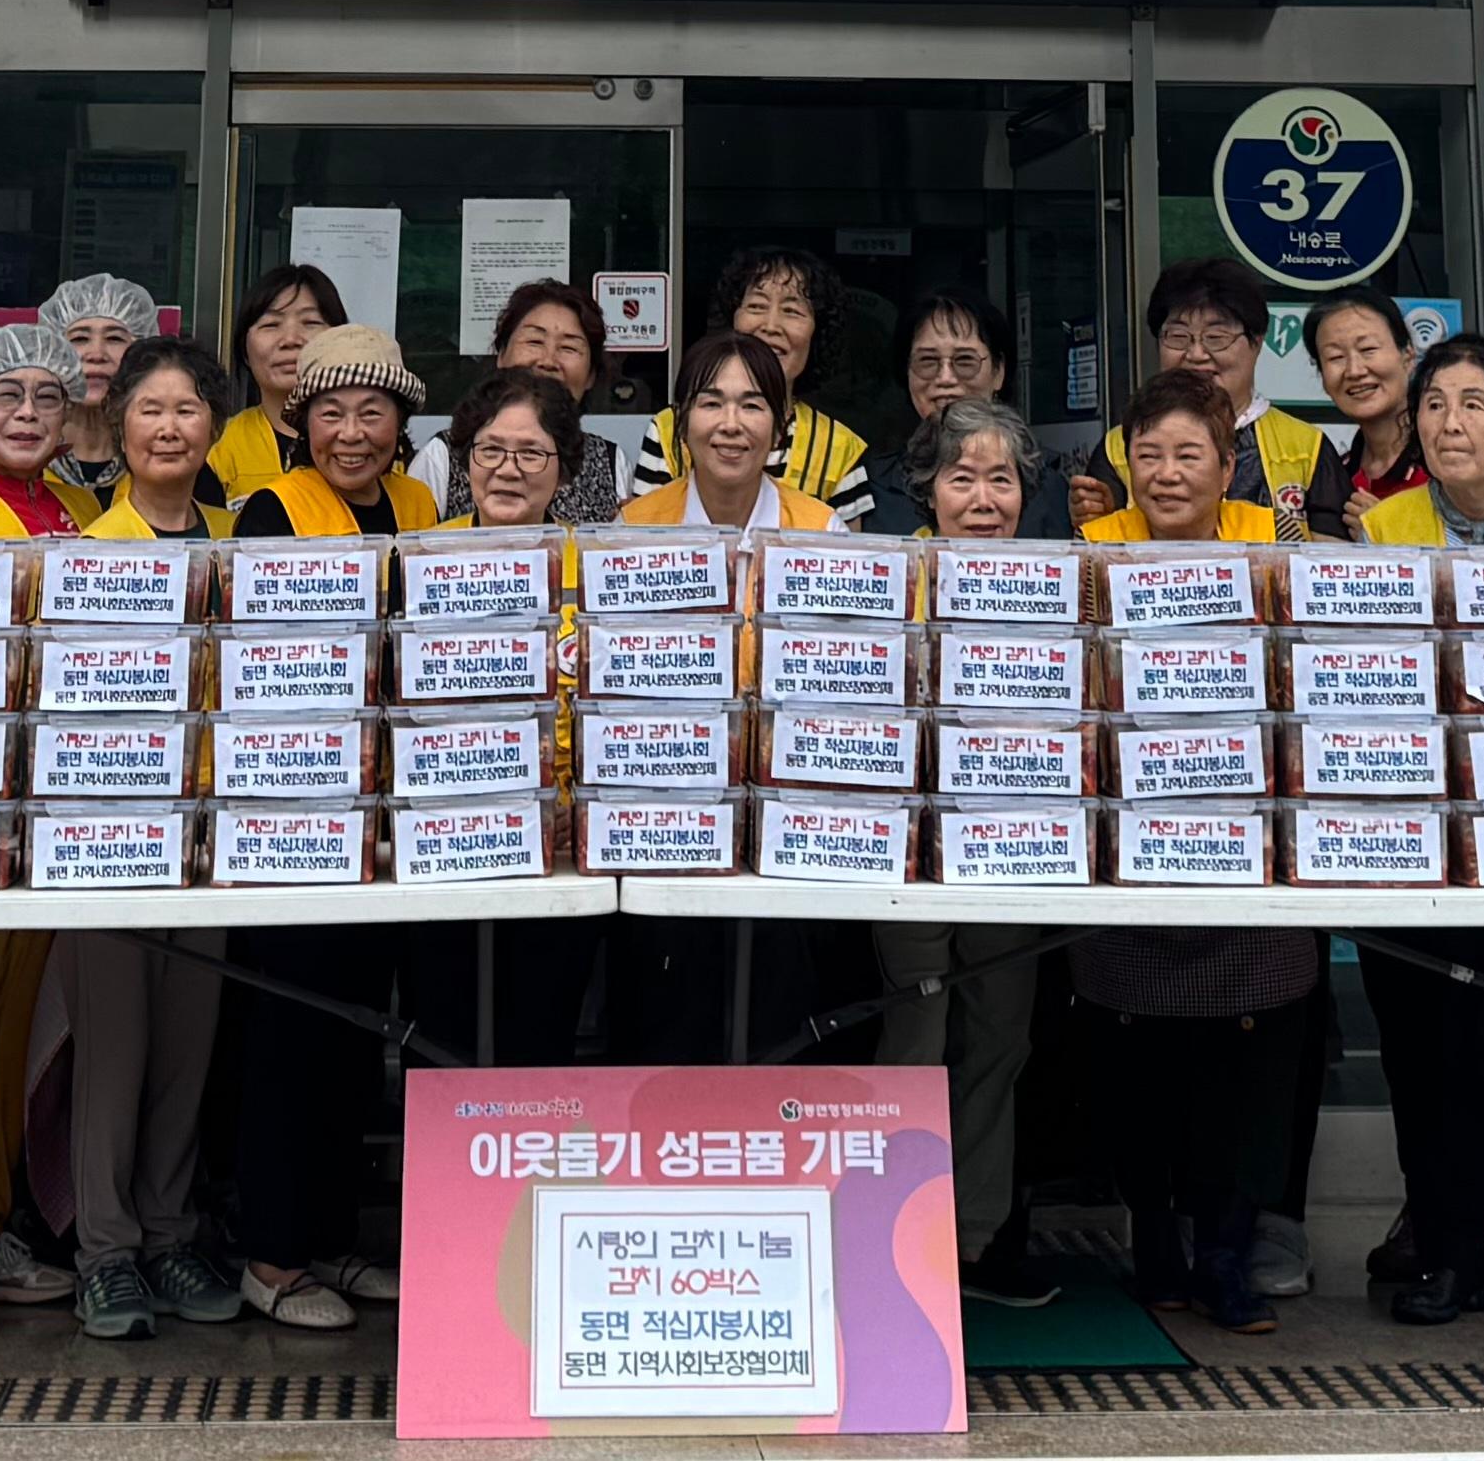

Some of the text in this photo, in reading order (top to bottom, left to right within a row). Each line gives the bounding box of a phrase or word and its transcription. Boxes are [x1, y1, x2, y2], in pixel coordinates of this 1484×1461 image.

[1259, 168, 1366, 222] 37
[1289, 231, 1341, 249] 내송로
[469, 1130, 887, 1178] 이웃돕기 성금품 기탁
[576, 1229, 793, 1259] 사랑의 김치 나눔
[608, 1266, 761, 1296] 김치 60박스
[580, 1309, 793, 1341] 동면 적십자봉사회
[564, 1350, 810, 1377] 동면 지역사회보장협의체
